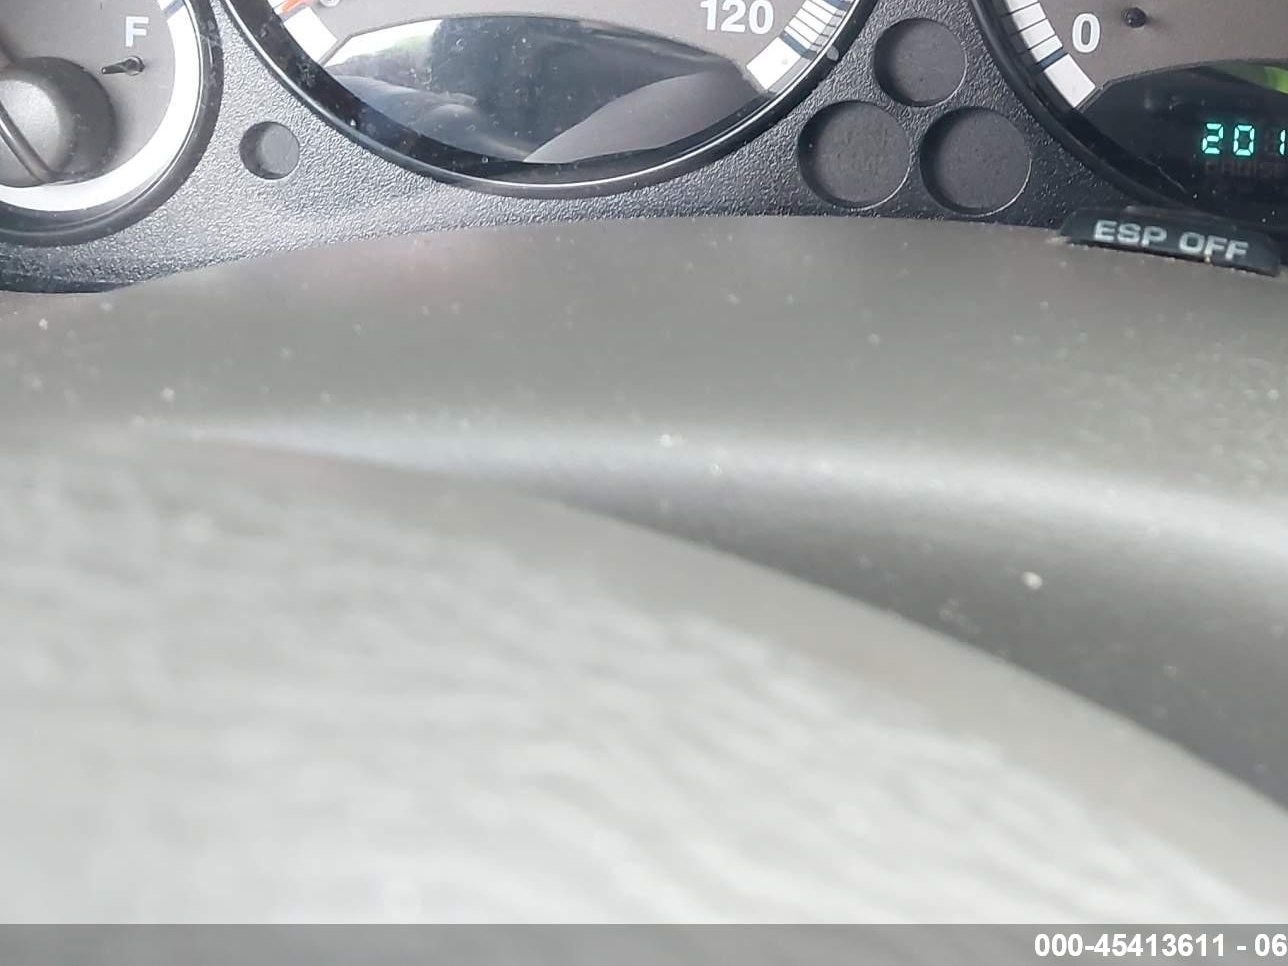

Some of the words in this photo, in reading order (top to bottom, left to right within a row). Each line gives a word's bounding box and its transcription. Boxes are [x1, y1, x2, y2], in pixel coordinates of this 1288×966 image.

[126, 17, 148, 46] F
[1072, 14, 1100, 52] 0
[1094, 220, 1167, 246] ESP
[1179, 232, 1248, 260] OFF
